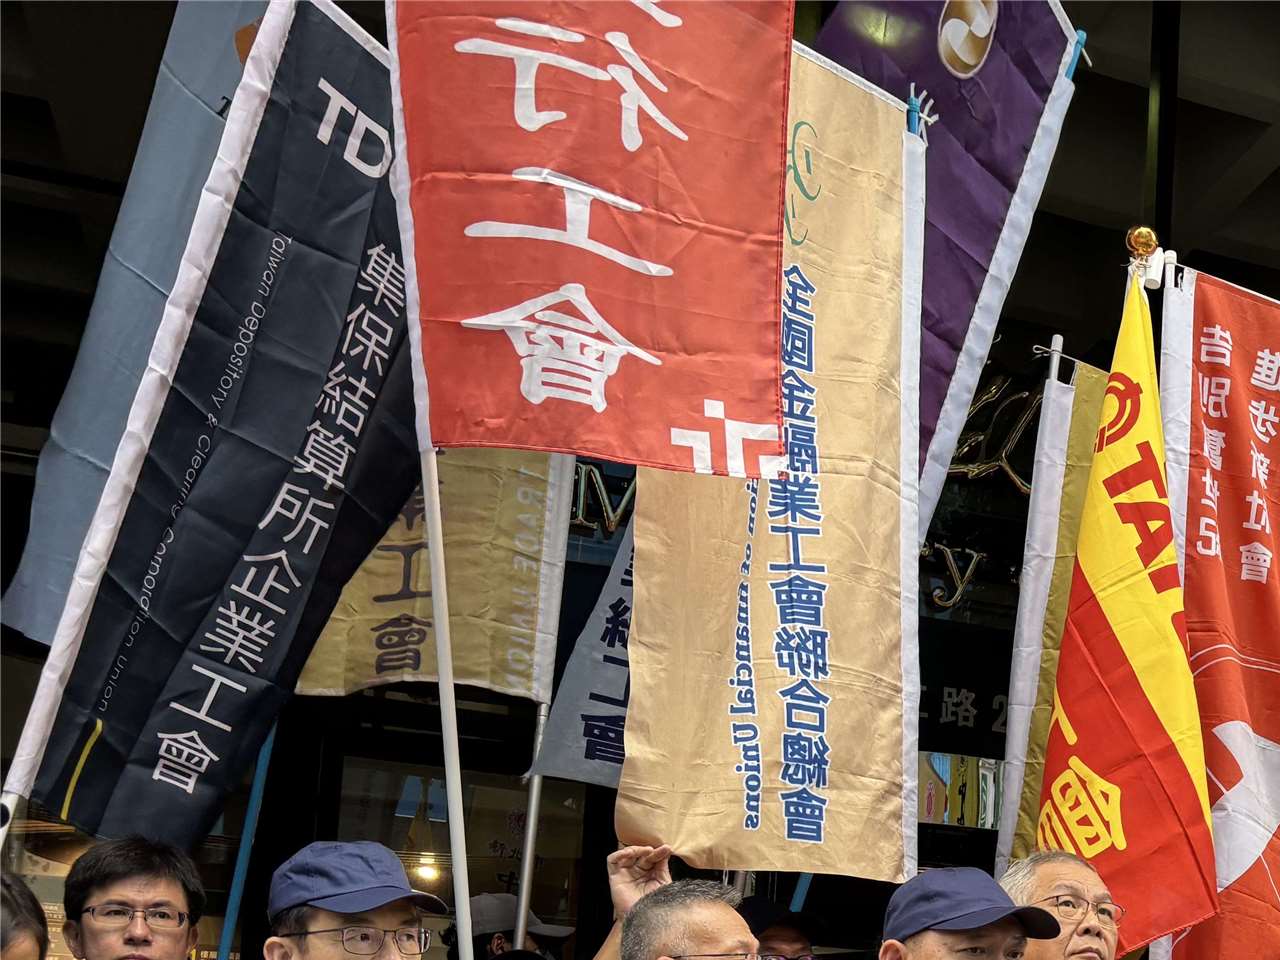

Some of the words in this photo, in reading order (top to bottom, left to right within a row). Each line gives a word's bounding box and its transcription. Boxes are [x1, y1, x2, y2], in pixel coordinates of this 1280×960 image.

[257, 231, 293, 297] Taiwan
[211, 301, 267, 410] Depository
[205, 413, 220, 428] &
[171, 435, 213, 519] Clearing
[152, 243, 405, 794] 集保結算所企業工會
[97, 653, 129, 713] Union
